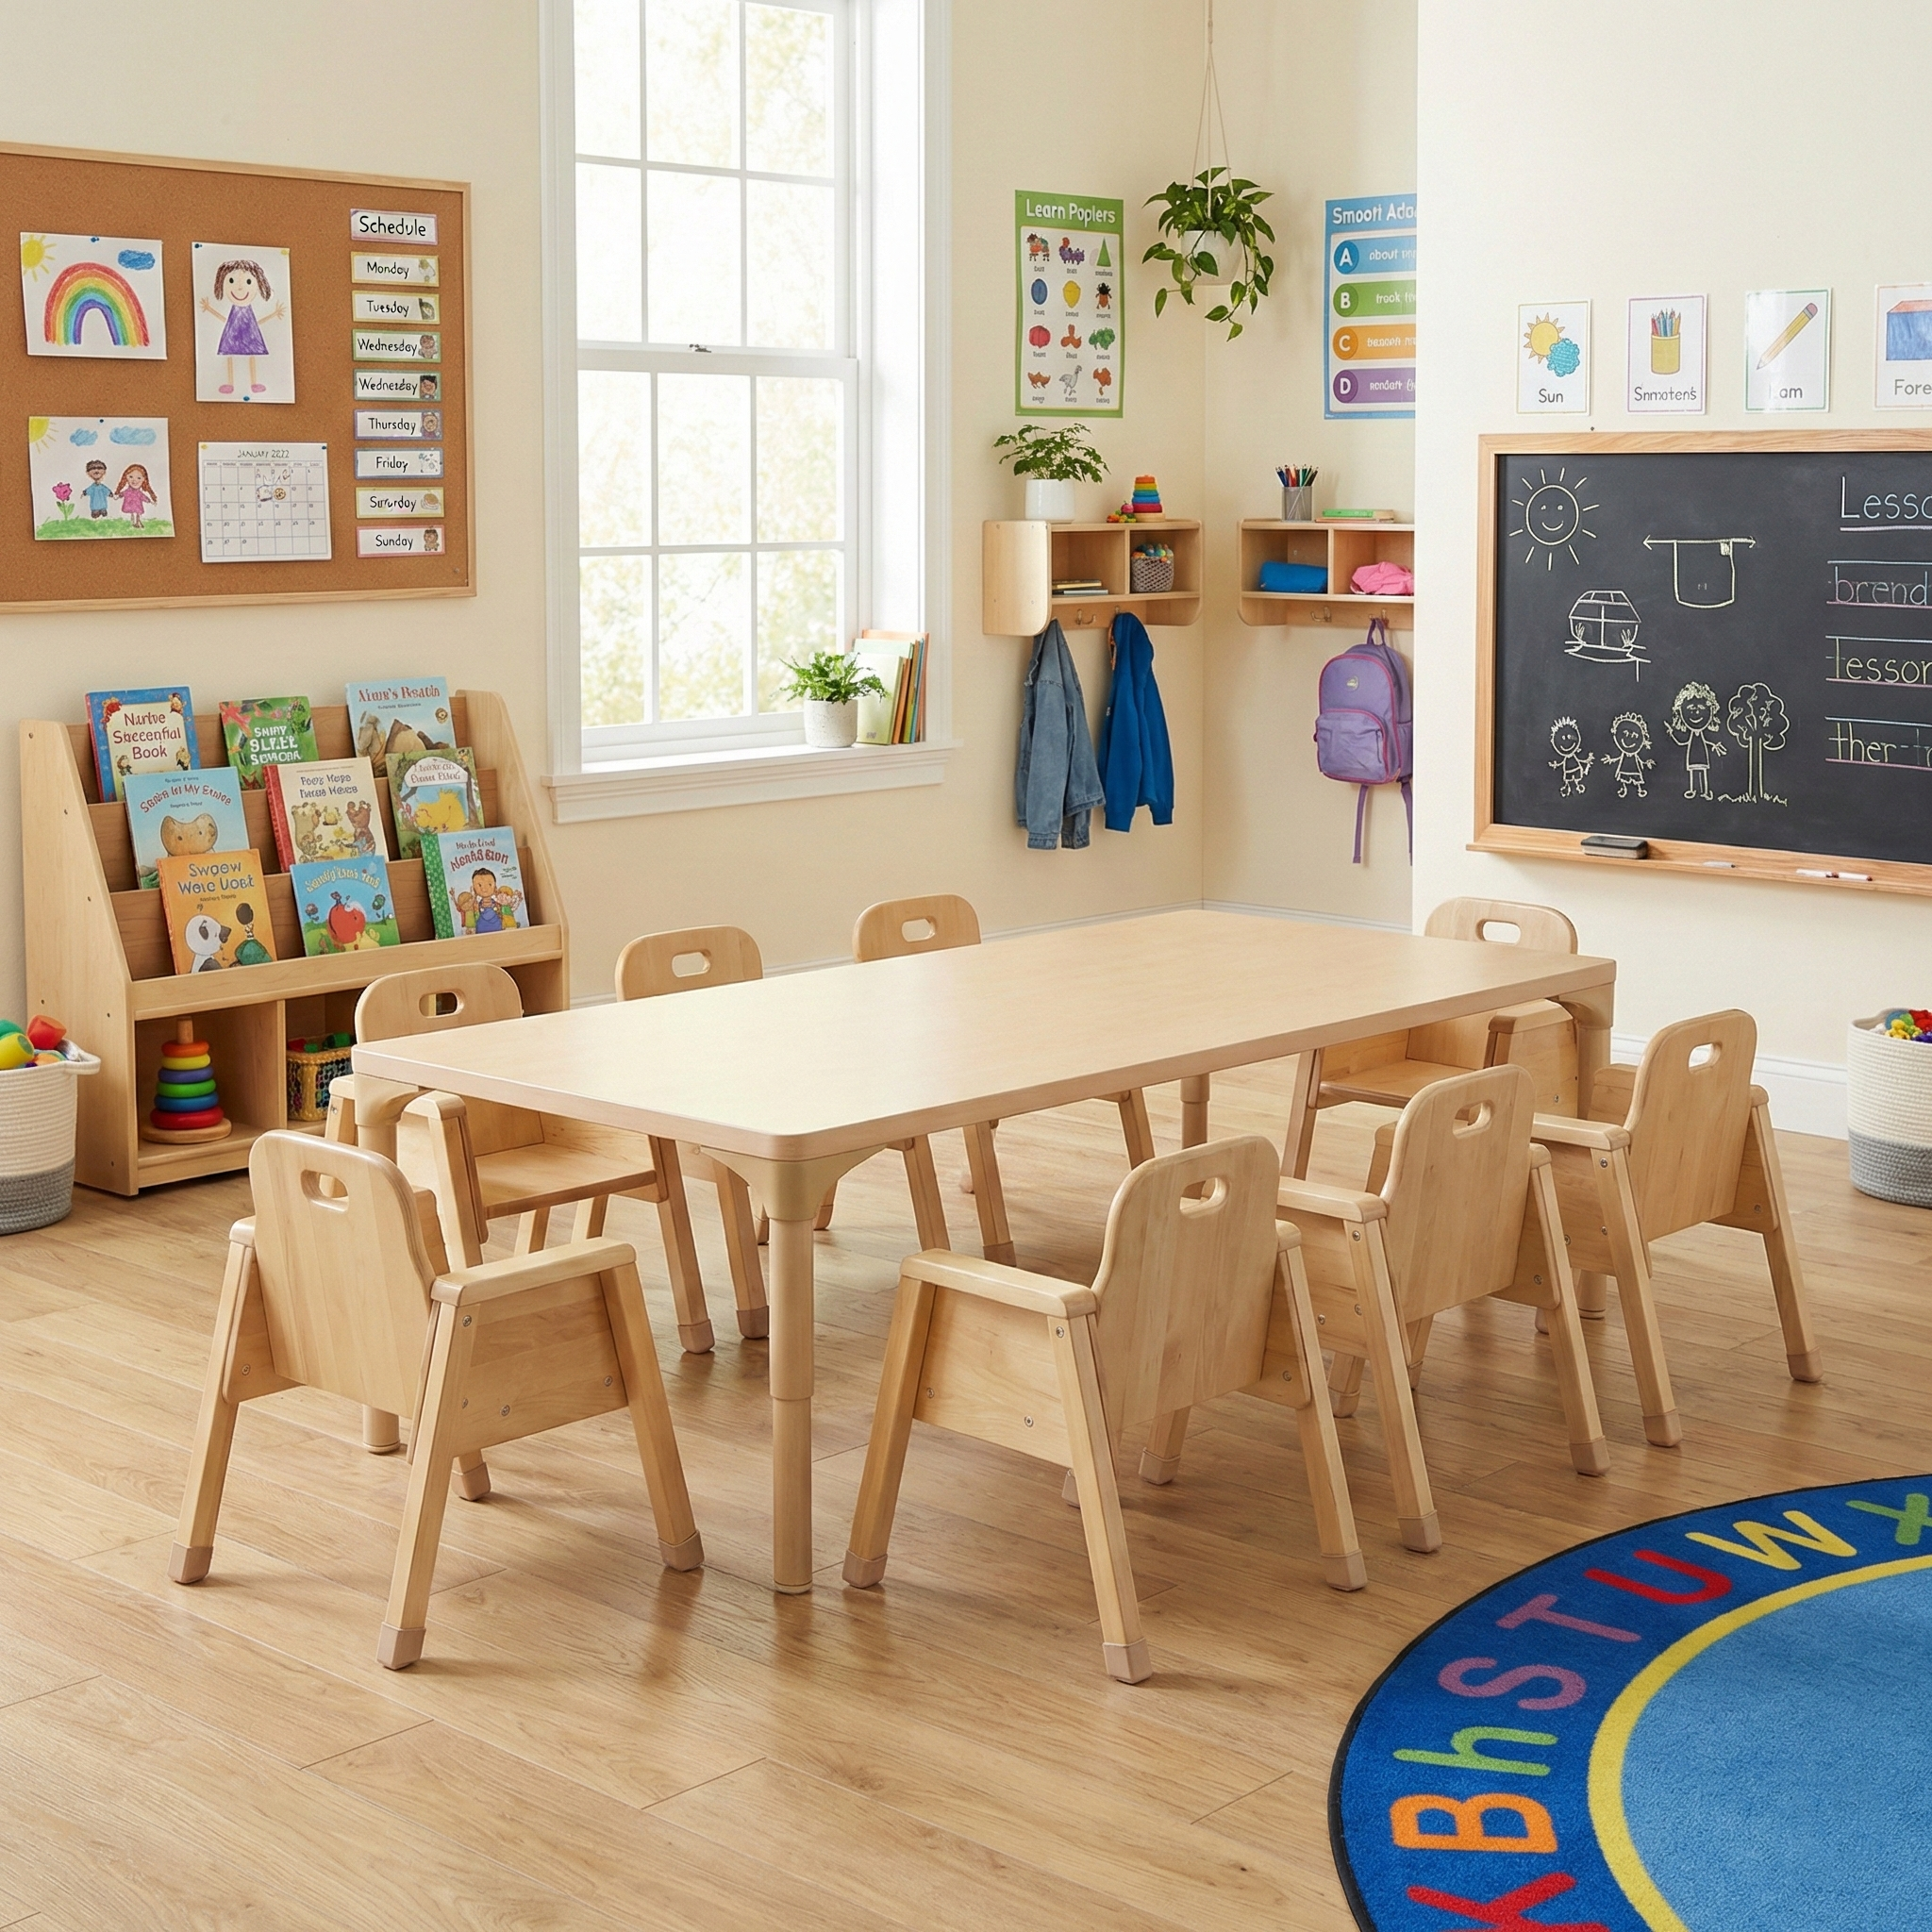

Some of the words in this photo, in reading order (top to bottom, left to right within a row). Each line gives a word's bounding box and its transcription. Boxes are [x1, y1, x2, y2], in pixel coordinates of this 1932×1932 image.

[1026, 198, 1066, 220] Learn
[359, 215, 426, 237] Schedule
[1339, 247, 1353, 267] A
[1340, 291, 1351, 309] B
[1339, 335, 1351, 352] C
[1340, 377, 1352, 395] D
[1769, 385, 1803, 399] am
[1894, 378, 1932, 395] Fore
[1539, 388, 1564, 403] Sun
[368, 417, 416, 435] Thursday
[375, 534, 414, 551] Sunday
[132, 744, 168, 759] Book
